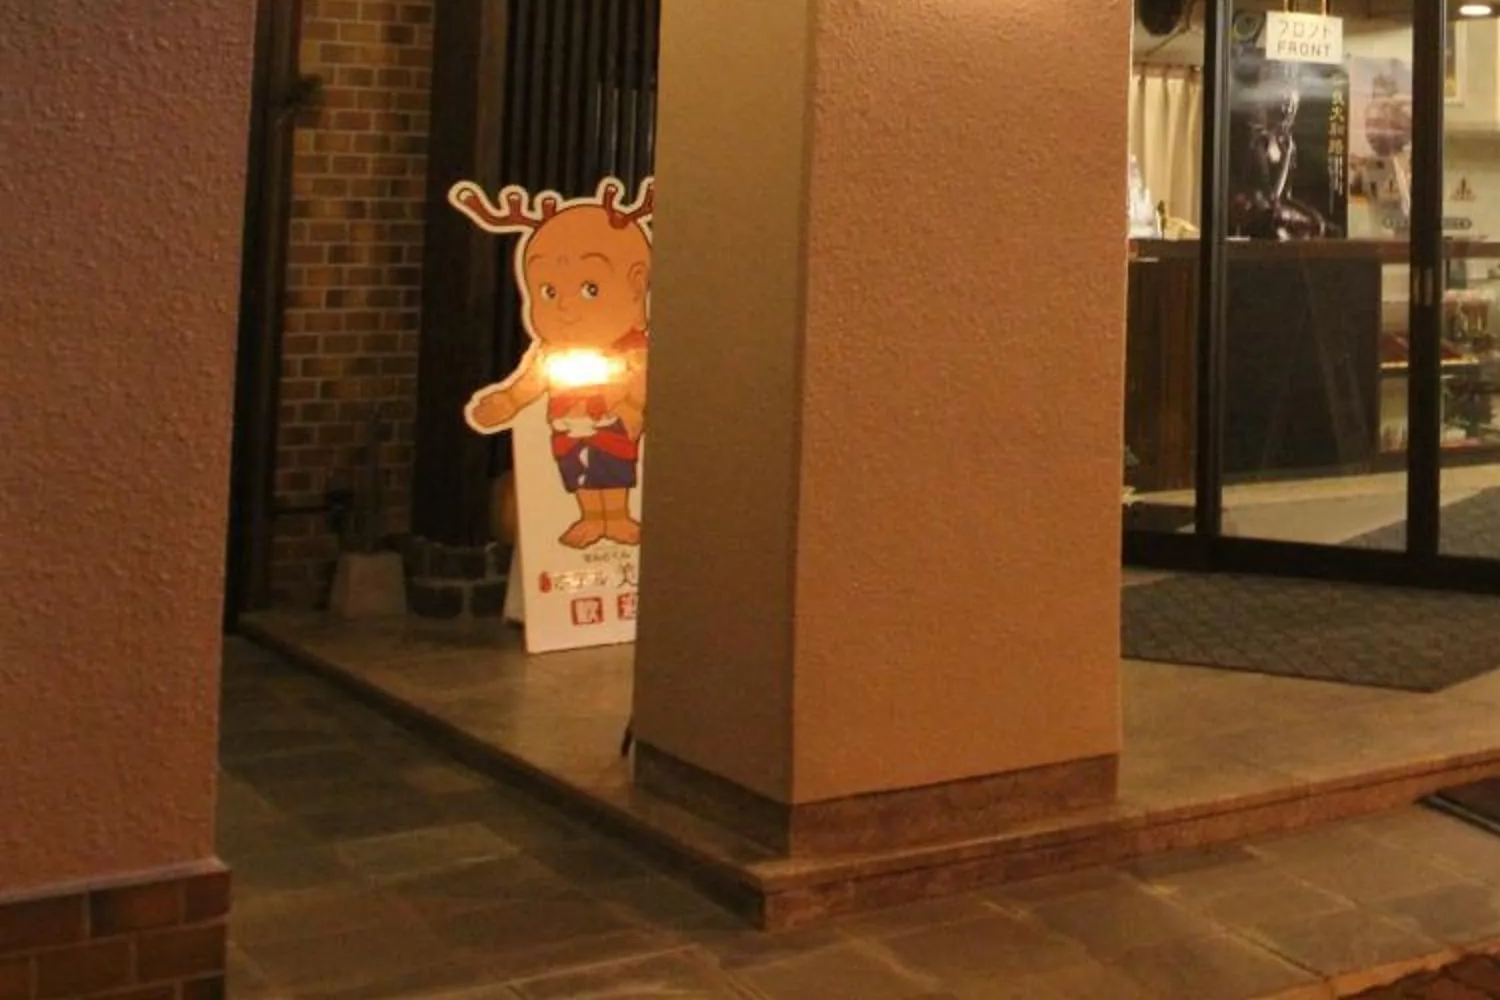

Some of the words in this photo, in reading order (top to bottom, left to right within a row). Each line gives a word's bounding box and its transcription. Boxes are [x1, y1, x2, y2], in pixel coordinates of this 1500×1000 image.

[1277, 19, 1332, 40] フロント
[1277, 40, 1332, 57] FRONT
